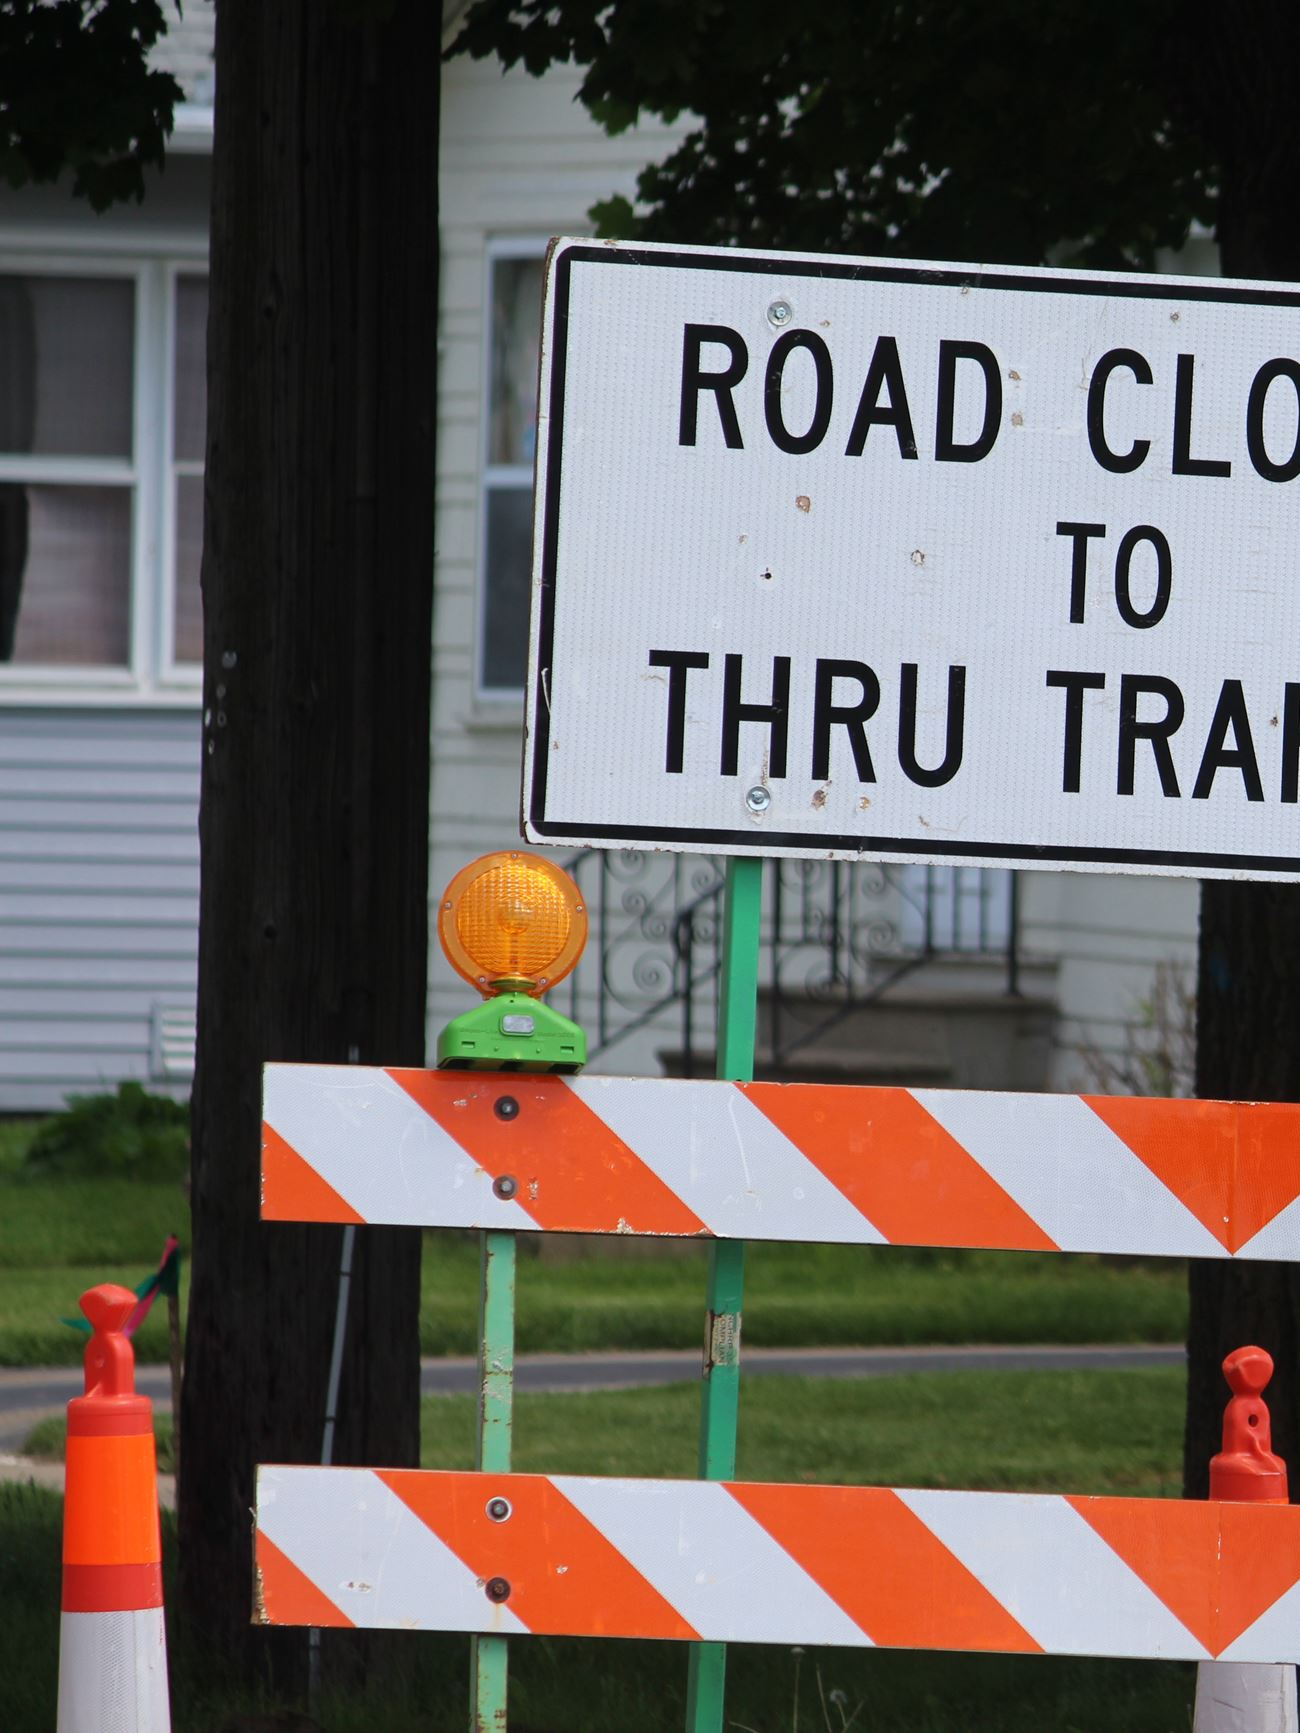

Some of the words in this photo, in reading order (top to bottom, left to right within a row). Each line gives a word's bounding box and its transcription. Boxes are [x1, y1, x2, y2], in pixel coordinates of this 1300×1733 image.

[679, 324, 1002, 462] ROAD
[1056, 522, 1172, 629] TO
[649, 650, 966, 787] THRU
